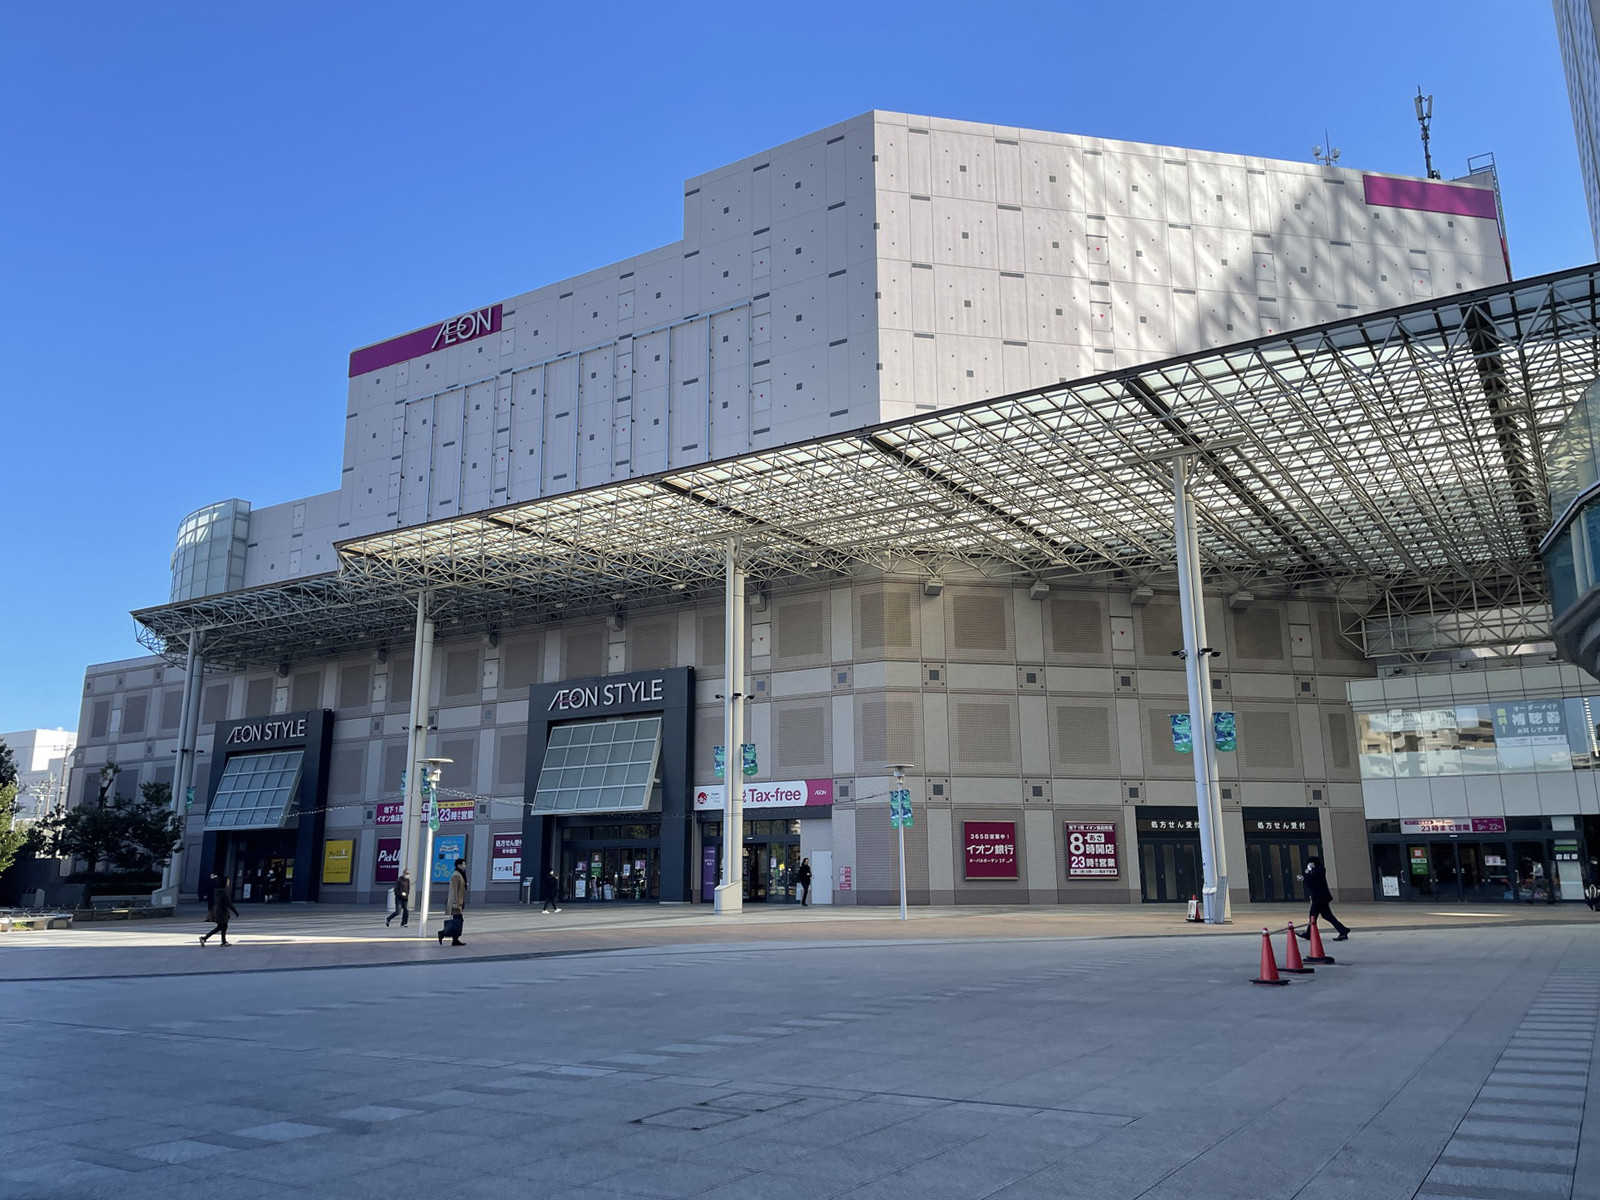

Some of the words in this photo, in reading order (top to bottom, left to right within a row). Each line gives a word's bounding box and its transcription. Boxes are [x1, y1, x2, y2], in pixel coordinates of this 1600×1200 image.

[603, 679, 663, 706] STYLE
[1511, 711, 1561, 726] 補聴器
[264, 719, 306, 741] STYLE
[748, 788, 801, 803] Tax-free
[1257, 822, 1305, 830] 処方せん受付
[966, 844, 1014, 855] イオン銀行
